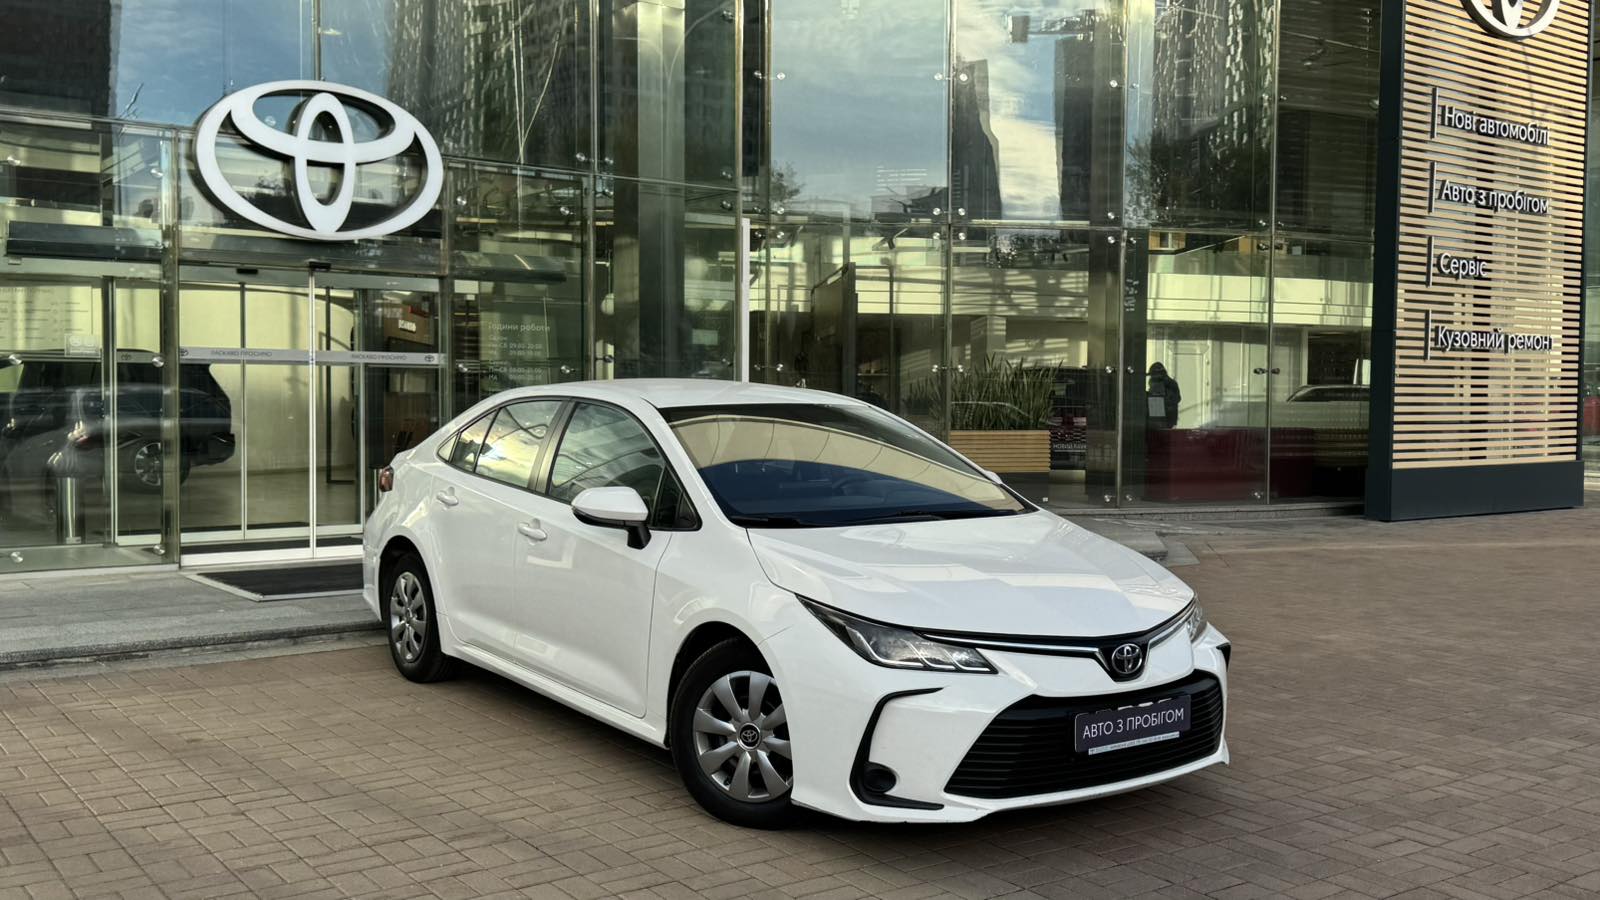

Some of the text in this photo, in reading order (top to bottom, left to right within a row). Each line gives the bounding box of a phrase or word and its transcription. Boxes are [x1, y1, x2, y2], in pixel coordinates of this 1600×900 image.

[1444, 104, 1551, 146] Нові автомобілі
[1441, 179, 1549, 213] Авто з пробігом
[1440, 252, 1488, 280] Сервіс
[1438, 324, 1504, 352] Кузовний
[1083, 720, 1114, 740] АВТО
[1126, 707, 1185, 731] ПРОБІГОМ
